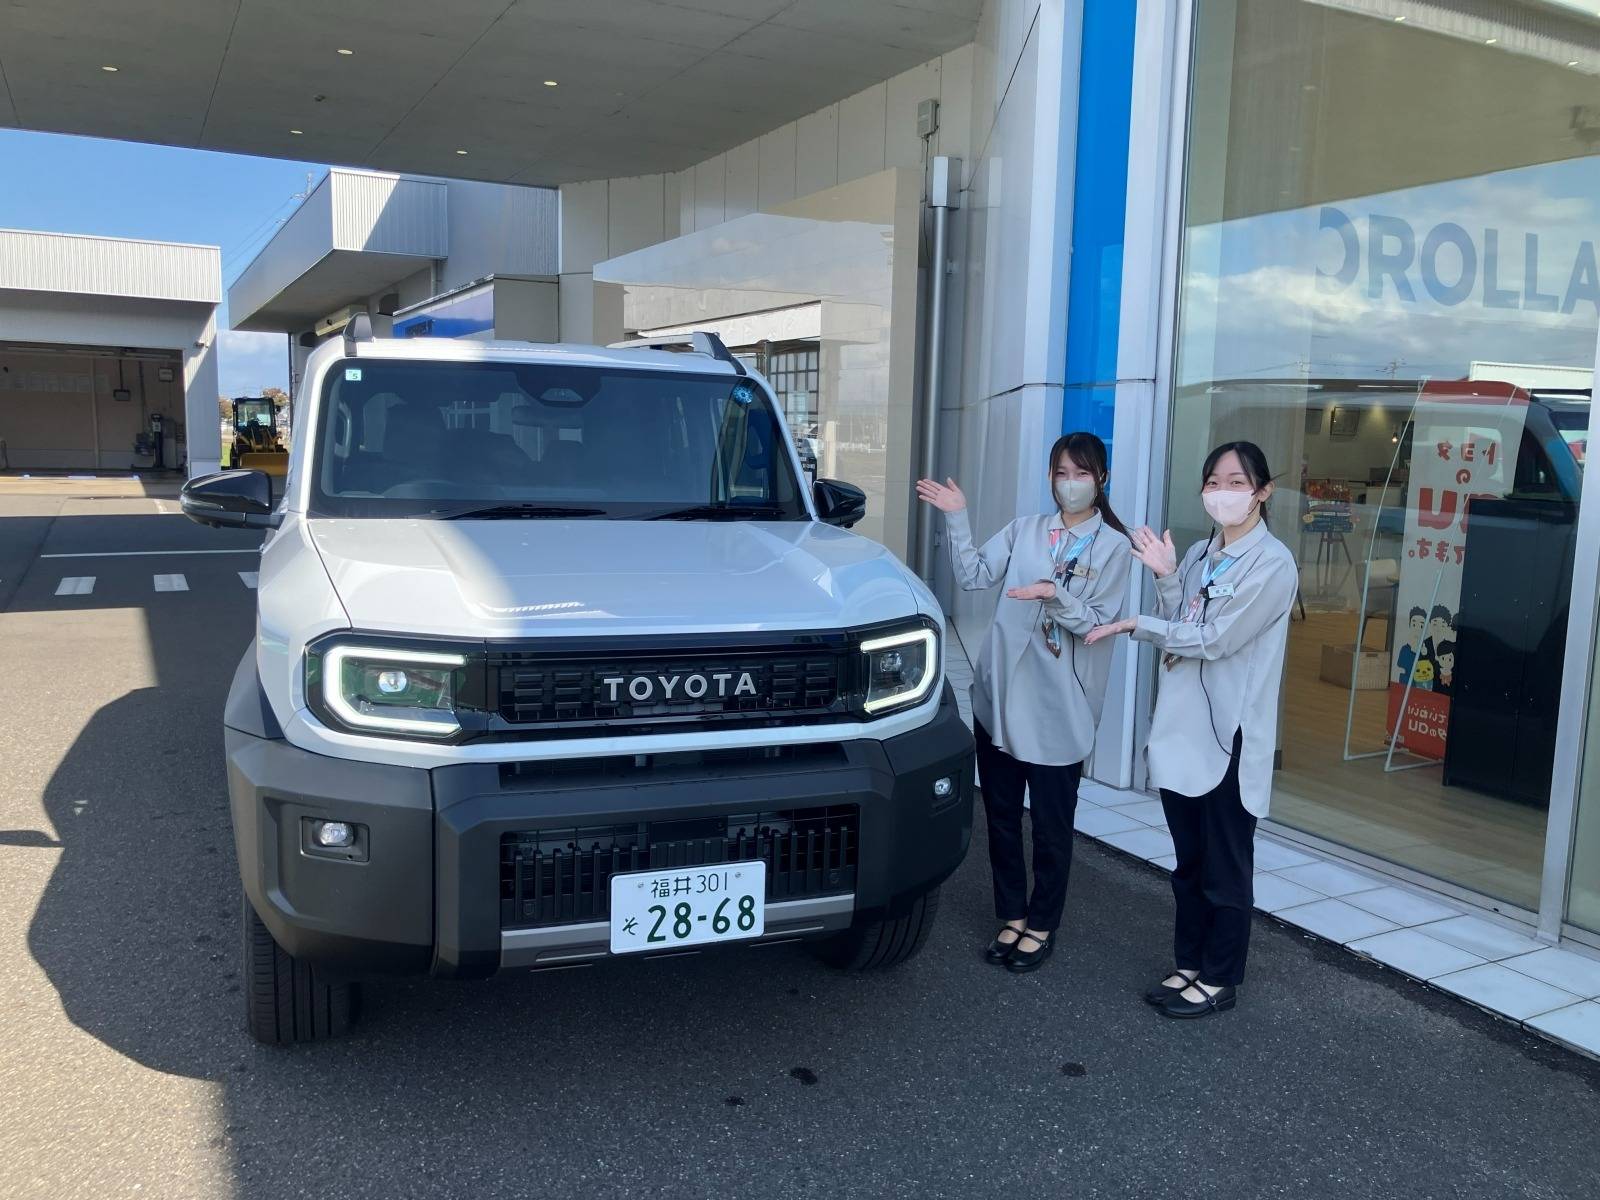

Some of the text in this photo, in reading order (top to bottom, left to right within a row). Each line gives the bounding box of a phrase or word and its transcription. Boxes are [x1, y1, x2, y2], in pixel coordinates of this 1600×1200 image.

[604, 673, 757, 701] TOYOTA
[651, 876, 691, 898] 福井
[622, 894, 755, 943] そ 28-68
